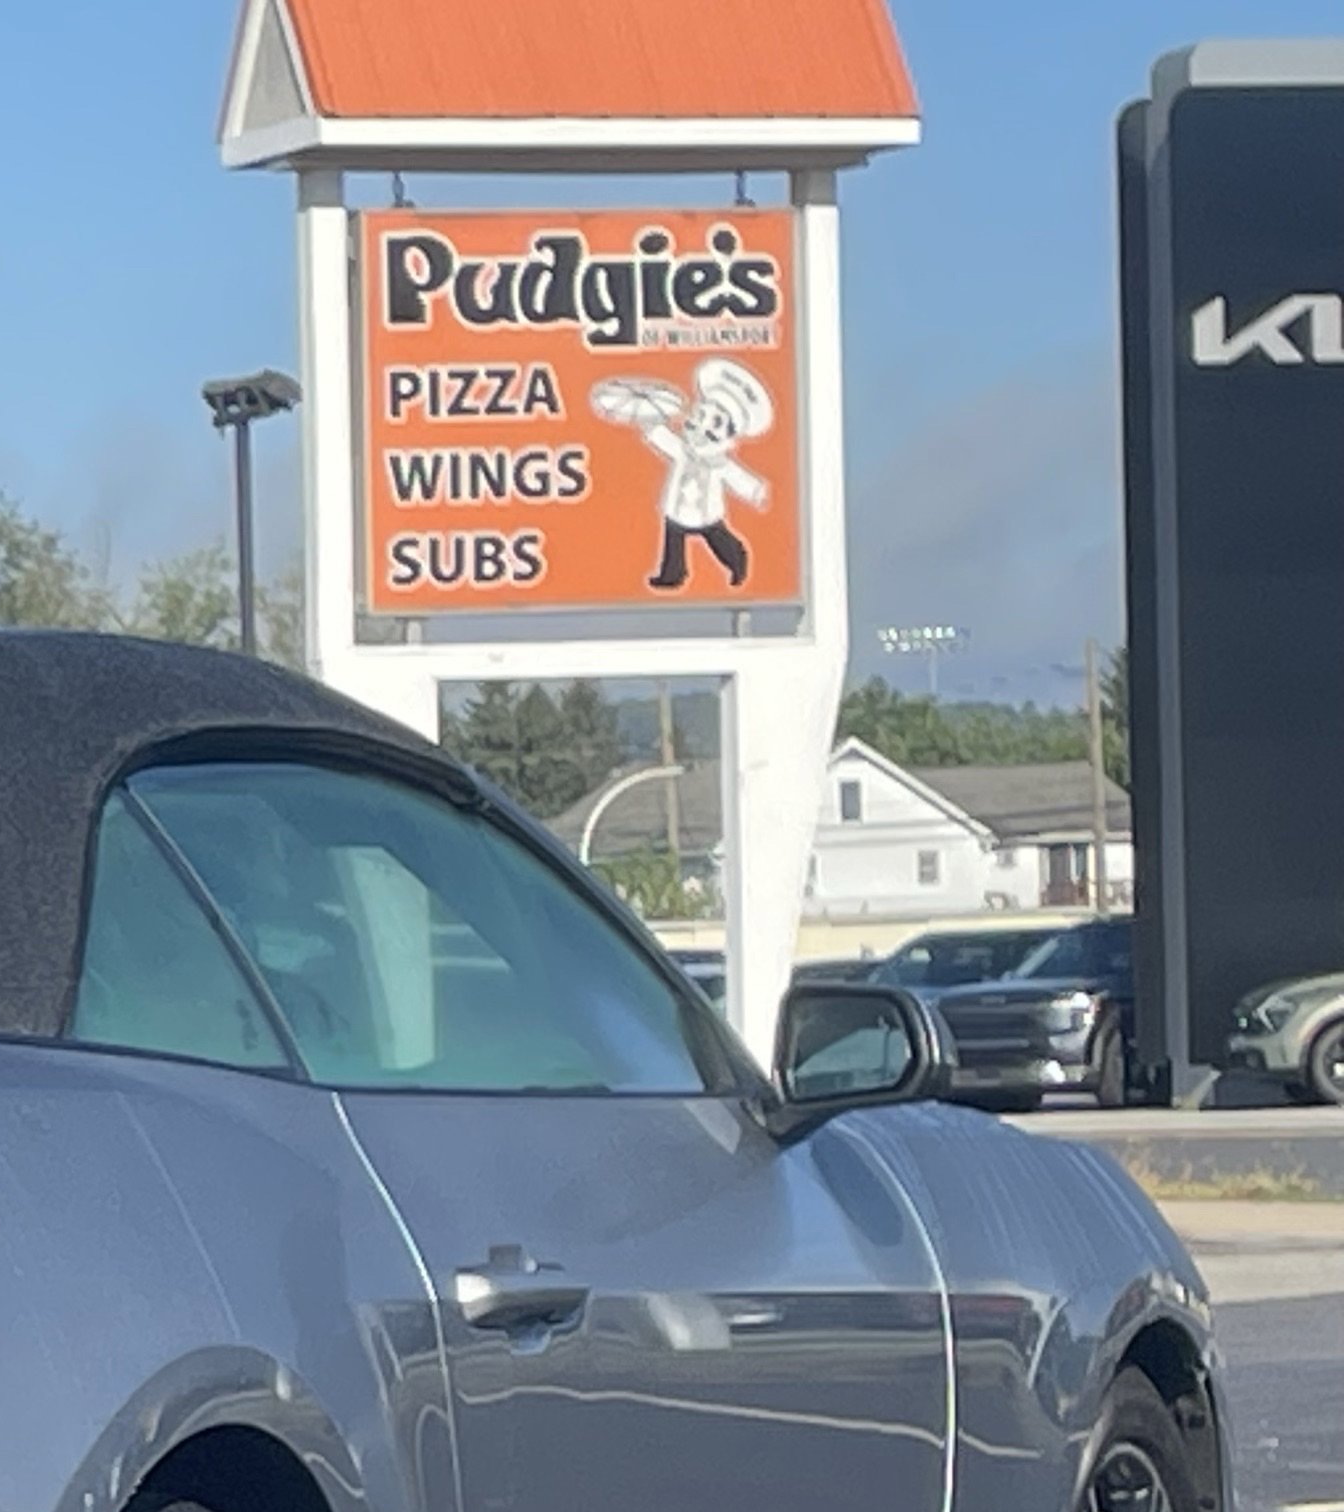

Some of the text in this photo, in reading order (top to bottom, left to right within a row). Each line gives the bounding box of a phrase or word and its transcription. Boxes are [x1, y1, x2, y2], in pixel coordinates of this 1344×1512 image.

[385, 230, 778, 347] Pudgie's
[1191, 294, 1344, 367] KI
[388, 368, 560, 418] PIZZA
[388, 450, 587, 502] WINGS
[390, 533, 543, 586] SUBS
